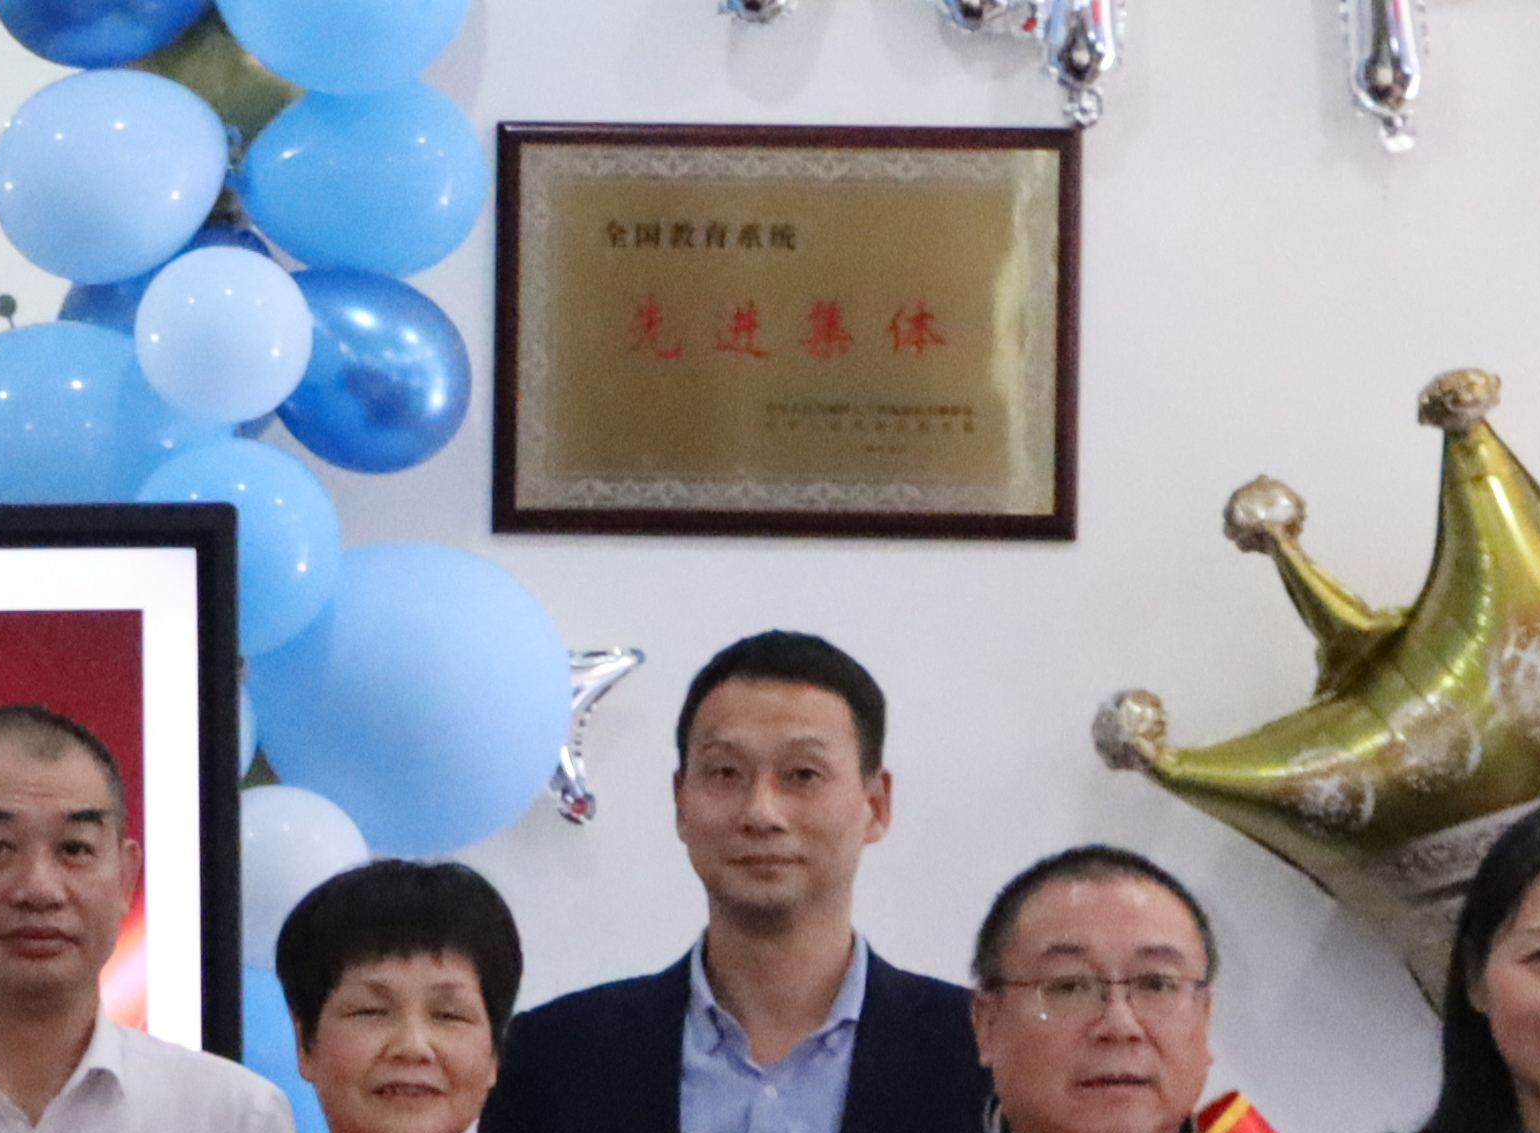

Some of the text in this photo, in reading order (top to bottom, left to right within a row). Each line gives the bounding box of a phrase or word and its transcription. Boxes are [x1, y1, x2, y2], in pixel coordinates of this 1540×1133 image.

[604, 220, 798, 252] 全国教育系统
[629, 294, 948, 360] 先进集体
